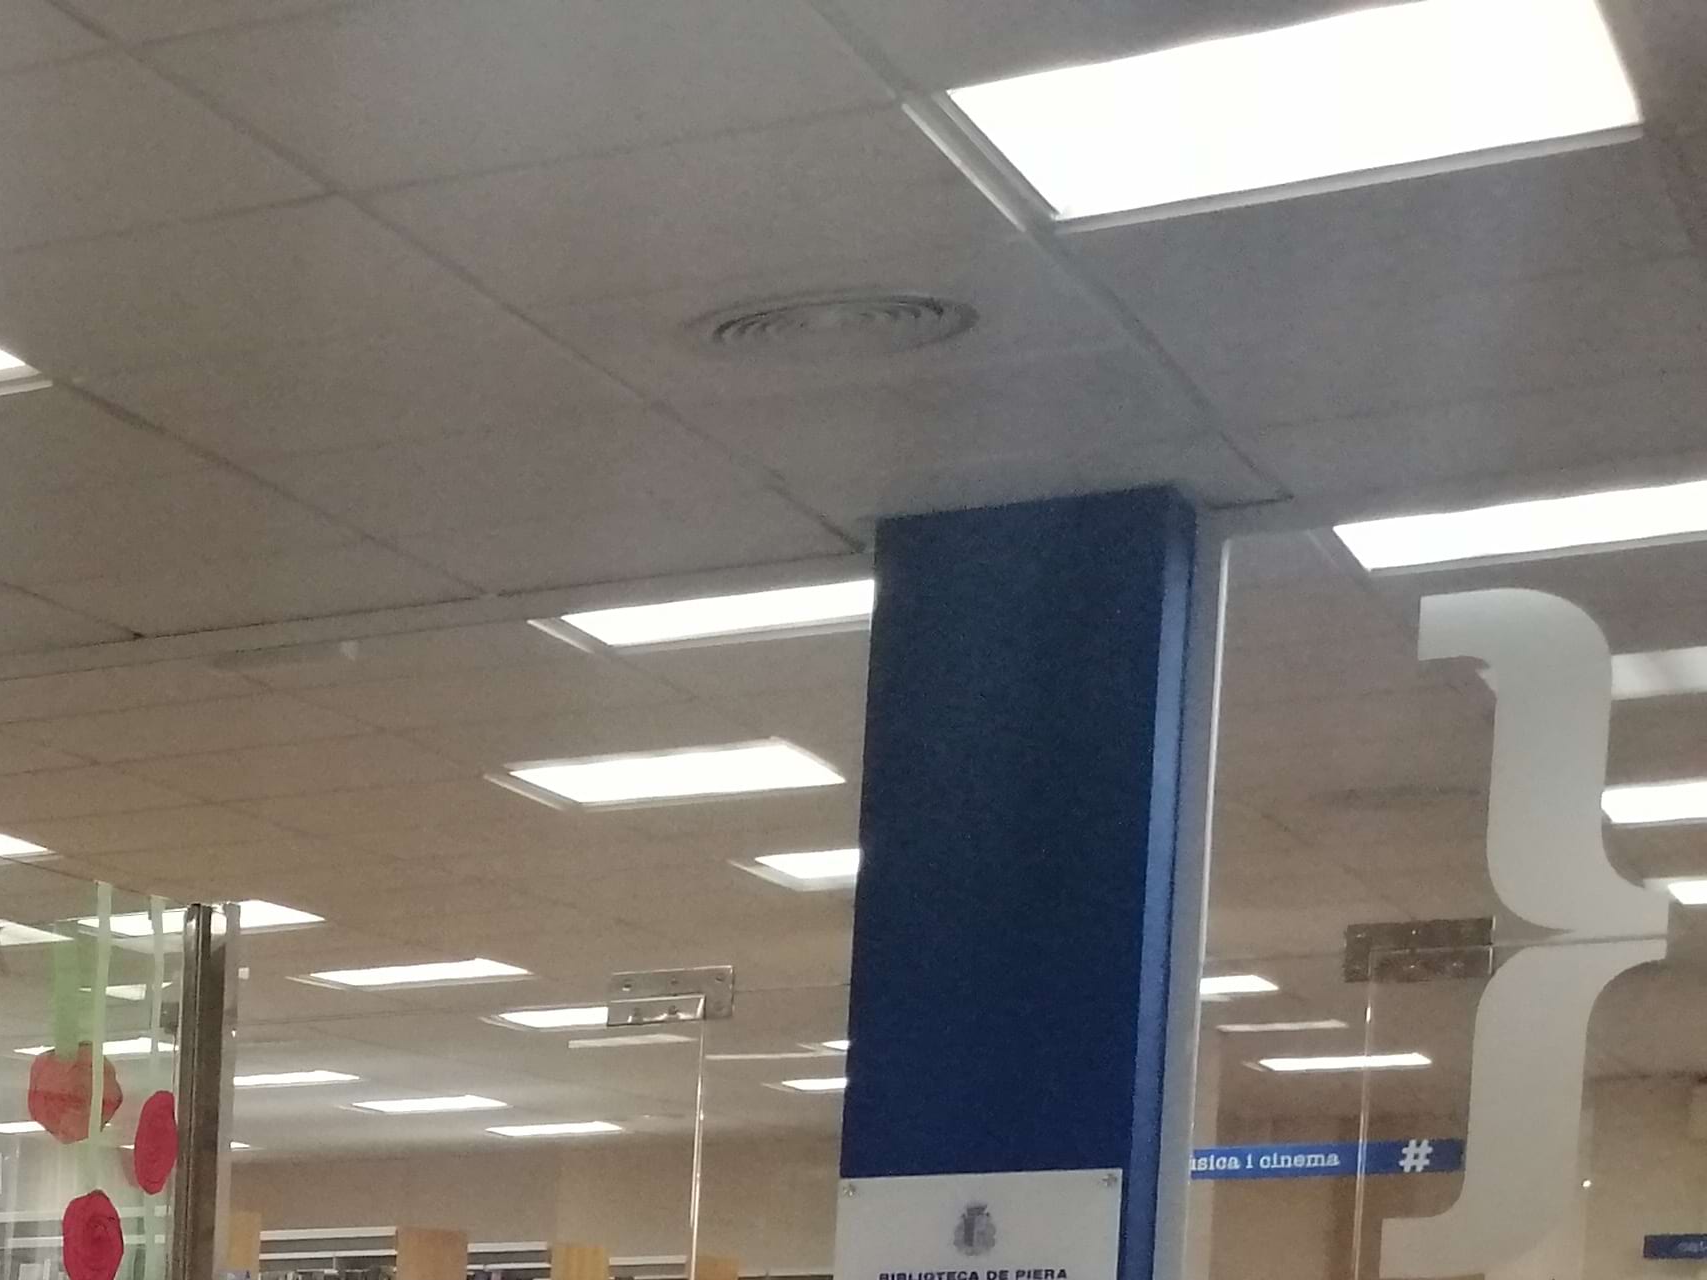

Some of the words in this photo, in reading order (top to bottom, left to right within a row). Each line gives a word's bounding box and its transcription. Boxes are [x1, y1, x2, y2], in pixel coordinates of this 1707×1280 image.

[1246, 1154, 1254, 1170] i
[1259, 1152, 1340, 1170] cinema
[1016, 1269, 1068, 1280] PIERA
